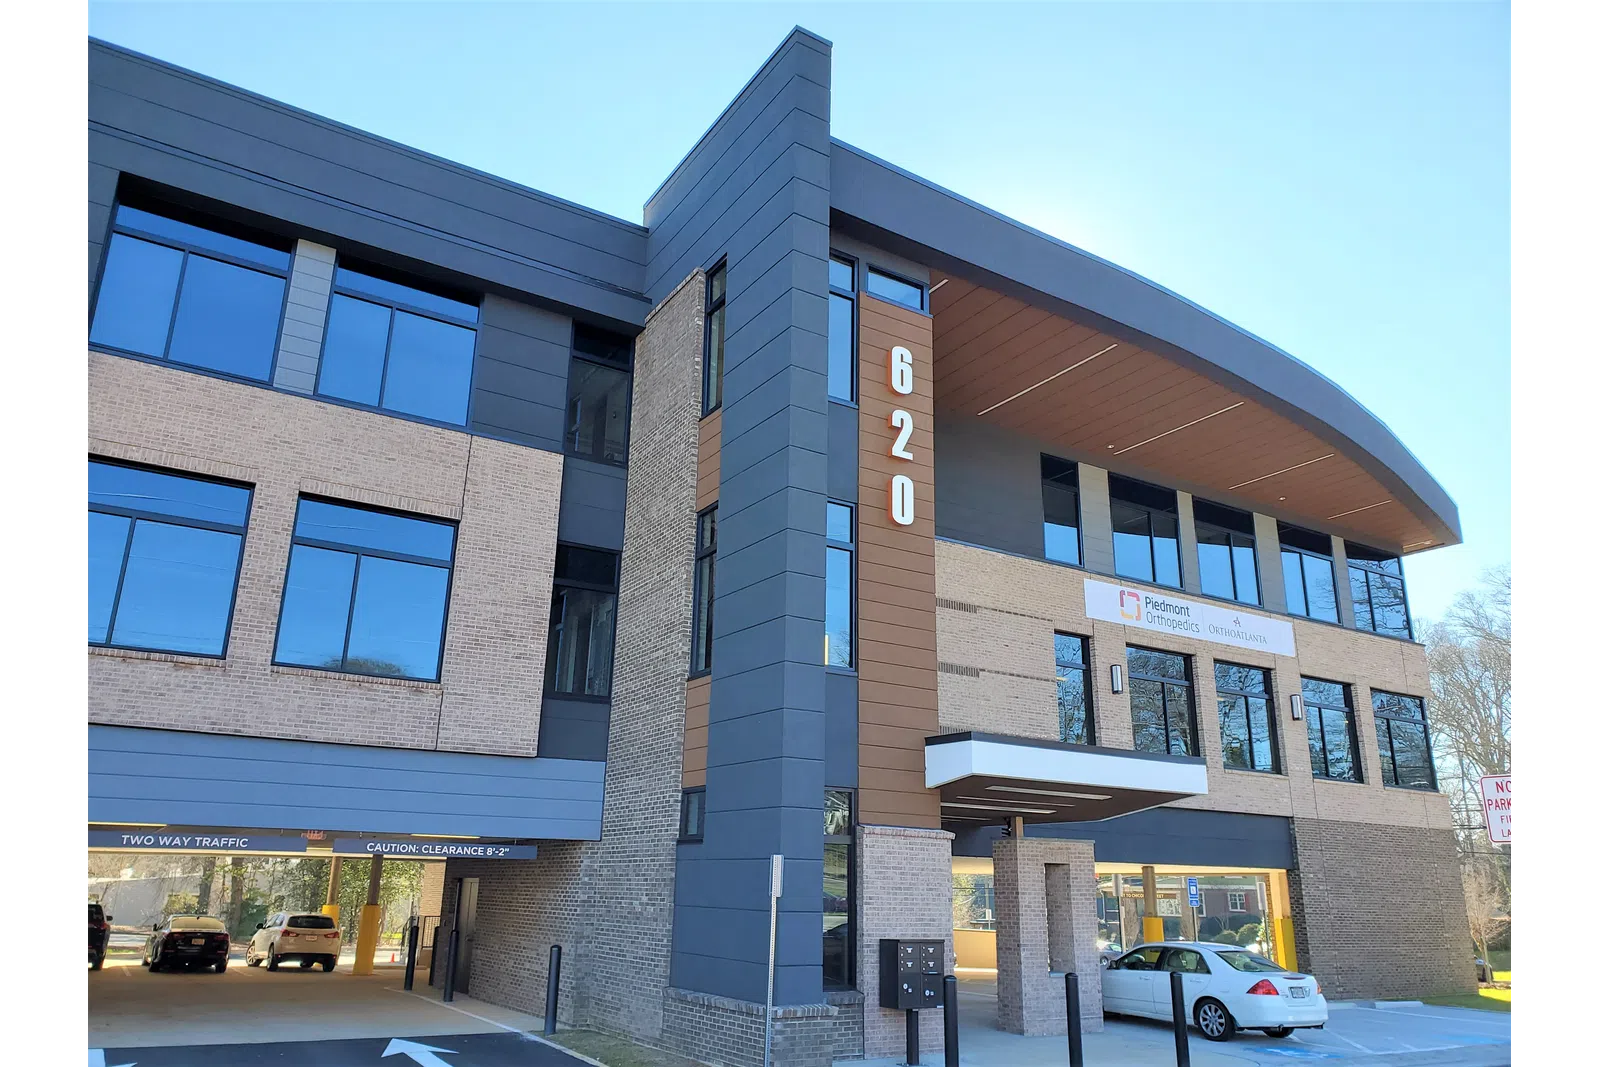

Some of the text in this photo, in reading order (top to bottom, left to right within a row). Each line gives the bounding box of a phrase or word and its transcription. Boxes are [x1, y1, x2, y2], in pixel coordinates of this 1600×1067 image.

[889, 345, 915, 526] 620
[1145, 596, 1190, 618] Piedmont
[1146, 611, 1200, 633] Orthopedics
[1208, 623, 1268, 644] ORTHOATLANTA
[121, 835, 249, 848] TWO WAY TRAFFIC
[366, 842, 419, 854] CAUTION:
[421, 844, 484, 856] CLEARANCE
